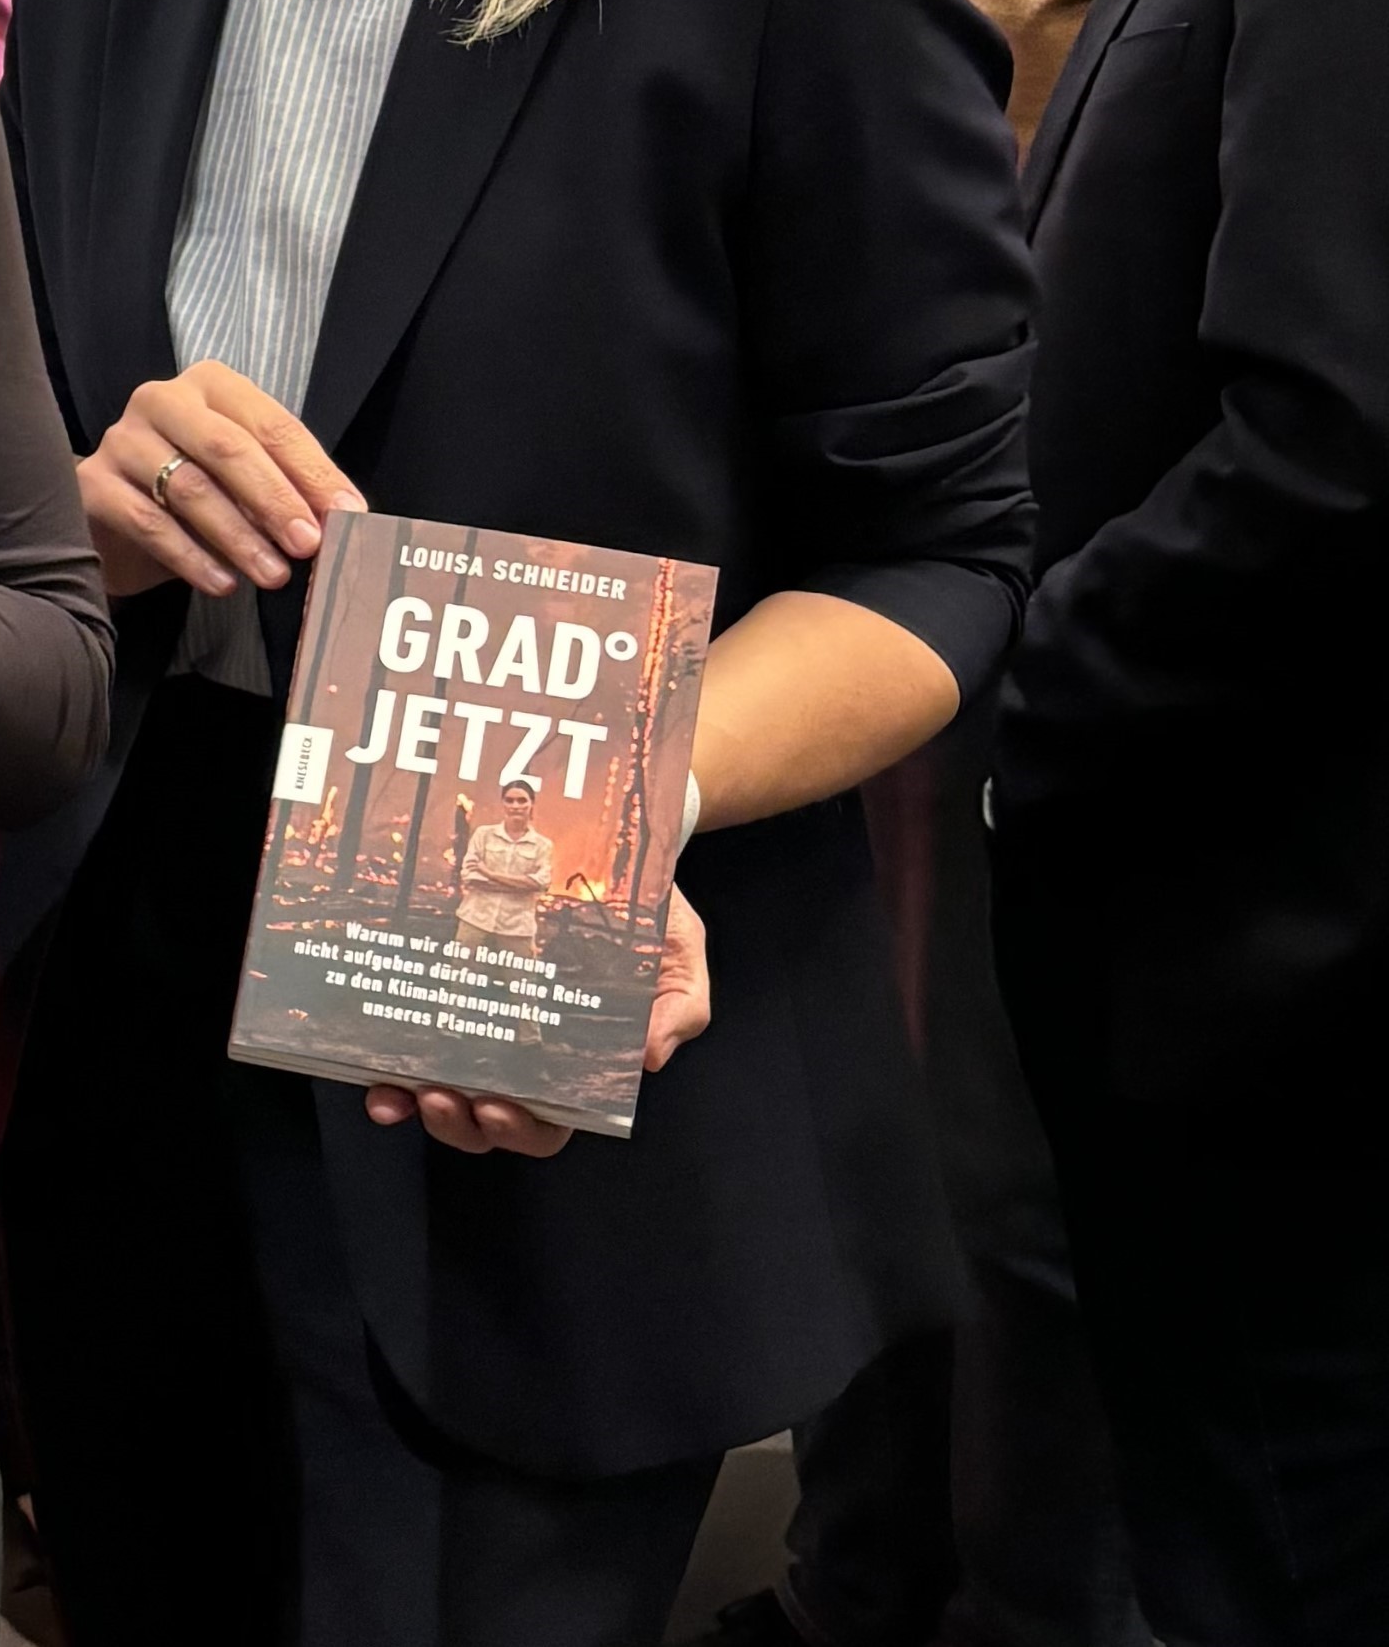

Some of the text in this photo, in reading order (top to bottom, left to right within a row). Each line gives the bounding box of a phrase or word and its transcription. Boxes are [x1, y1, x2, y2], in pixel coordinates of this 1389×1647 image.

[399, 546, 626, 601] LOUISA SCHNEIDER
[378, 596, 638, 700] GRAD°
[295, 736, 313, 791] KNESEBECK
[345, 689, 607, 799] JETZT
[294, 939, 339, 960] nicht
[343, 947, 424, 976] aufgeben
[429, 960, 488, 988] dürfen
[509, 977, 548, 999] eine
[552, 984, 601, 1010] Reise
[345, 921, 556, 979] Warum wir die Hoffnung
[325, 968, 561, 1027] zu den Klimabrennpunkten
[362, 1000, 516, 1042] unseres Planeten
